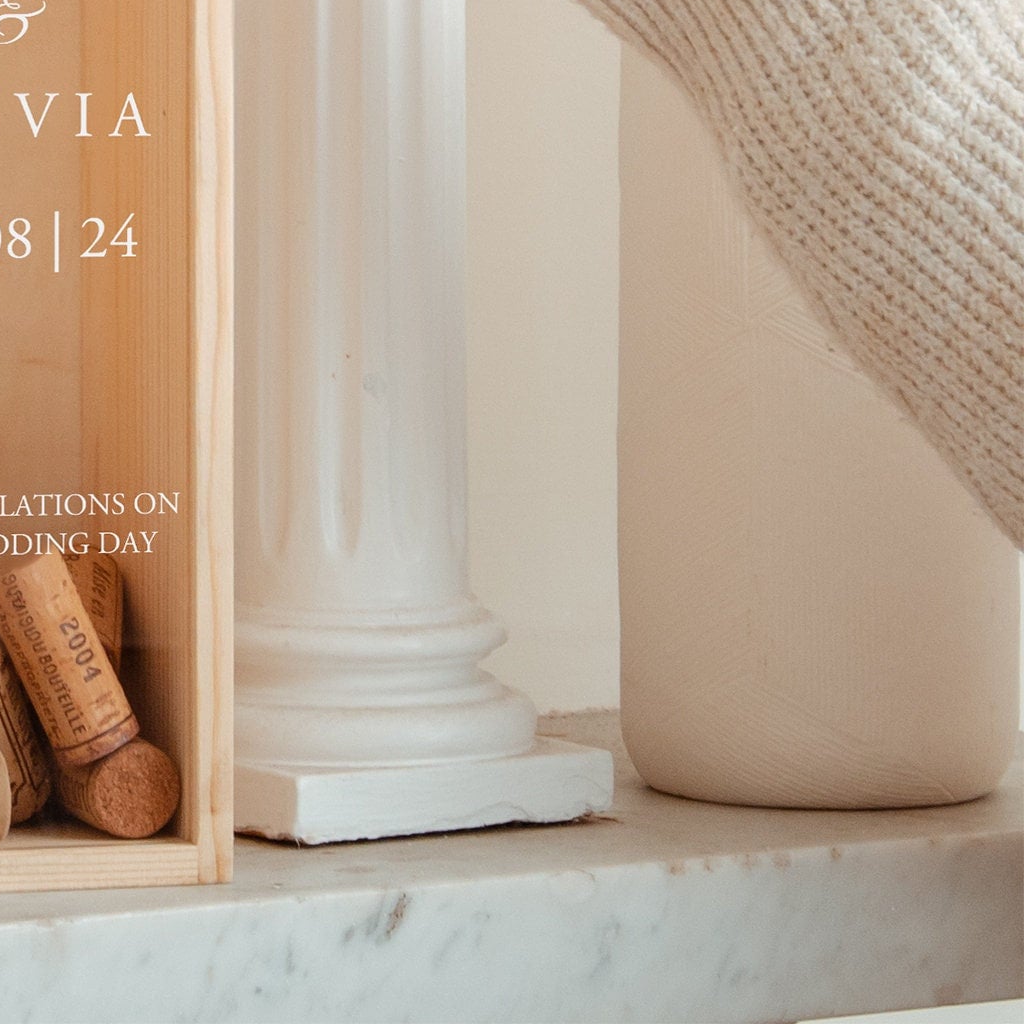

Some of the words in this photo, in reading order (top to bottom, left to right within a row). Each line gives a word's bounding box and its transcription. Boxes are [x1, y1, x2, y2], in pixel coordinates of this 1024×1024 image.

[133, 492, 180, 515] ON
[98, 531, 159, 554] DAY
[60, 616, 102, 683] 2004
